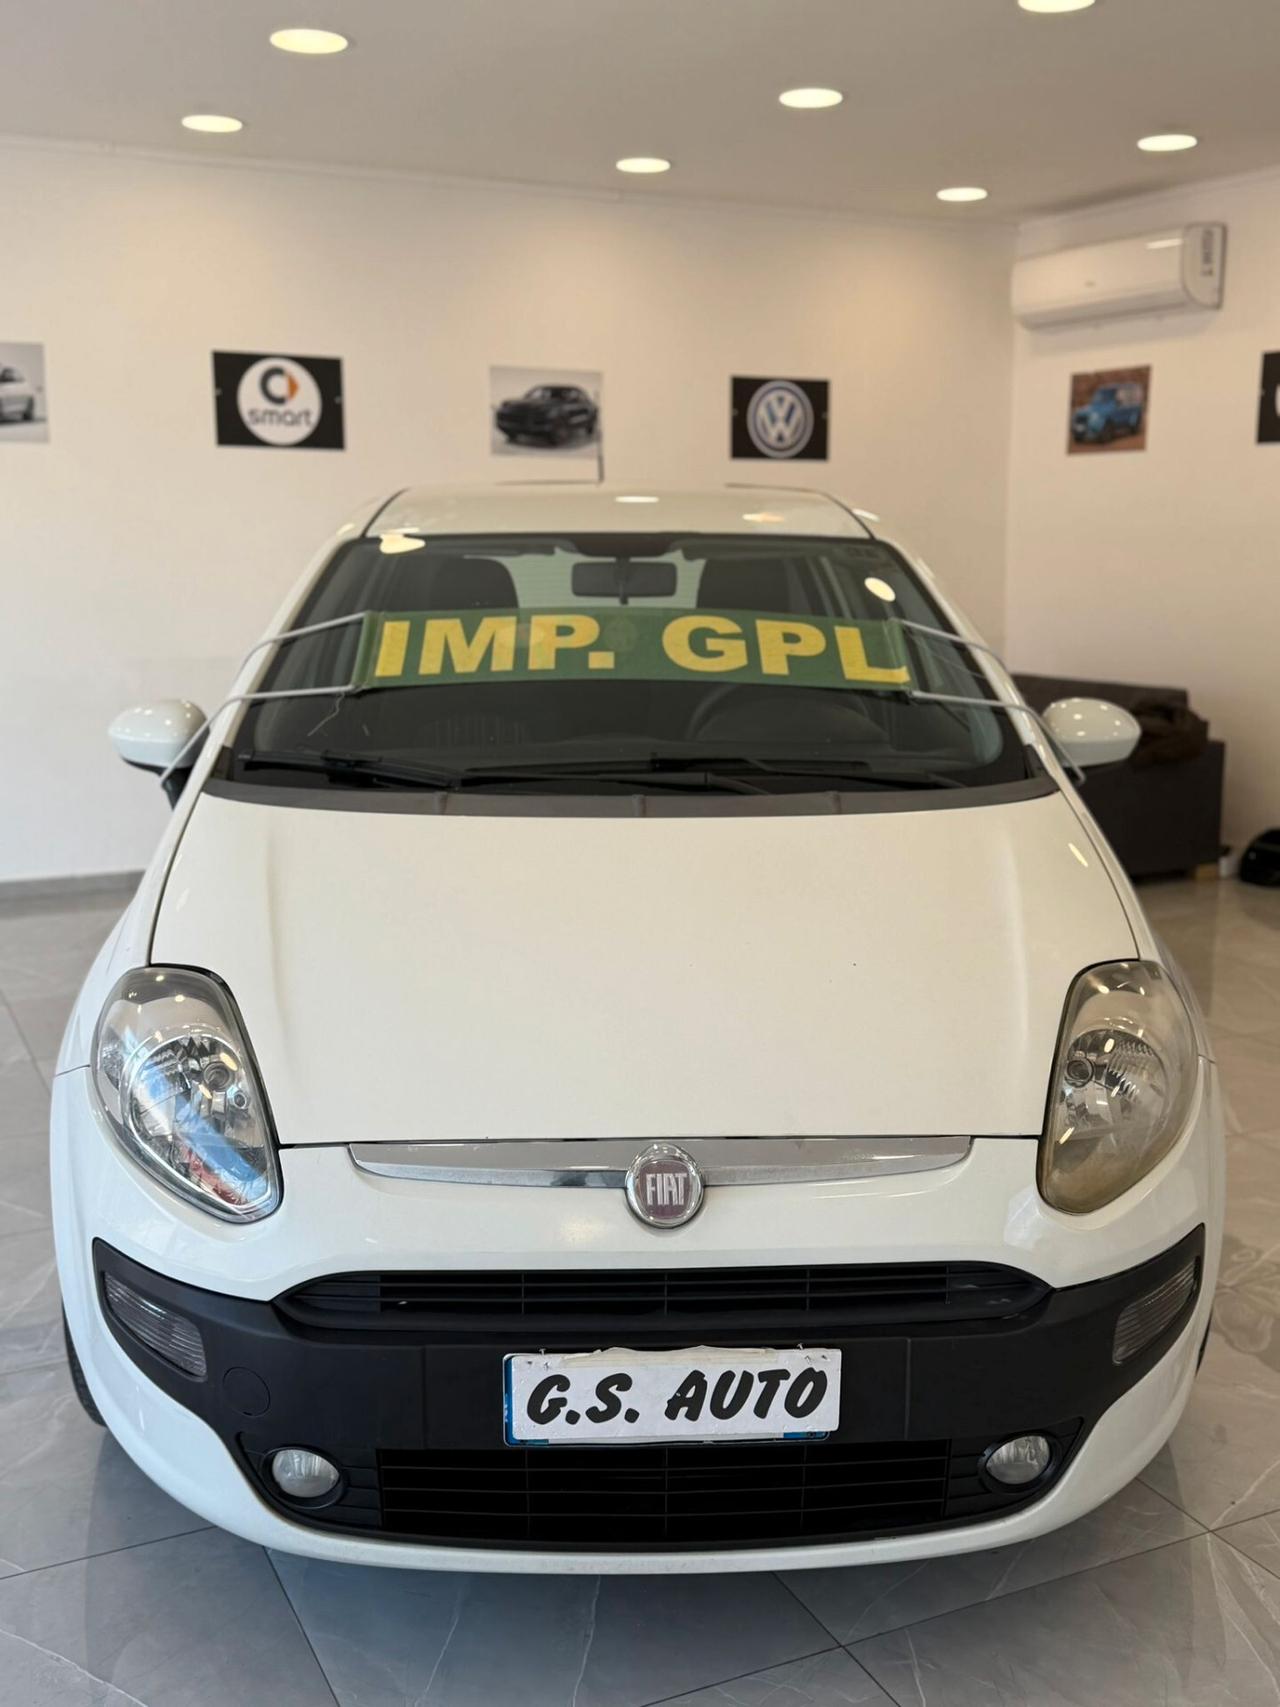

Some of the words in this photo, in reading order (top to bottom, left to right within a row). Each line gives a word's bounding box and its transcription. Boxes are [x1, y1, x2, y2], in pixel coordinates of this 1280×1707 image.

[247, 408, 312, 427] smart
[374, 615, 615, 677] IMP.
[661, 615, 911, 684] GPL
[645, 1172, 688, 1206] FIAT
[527, 1374, 640, 1425] G.S.
[664, 1367, 828, 1422] AUTO
